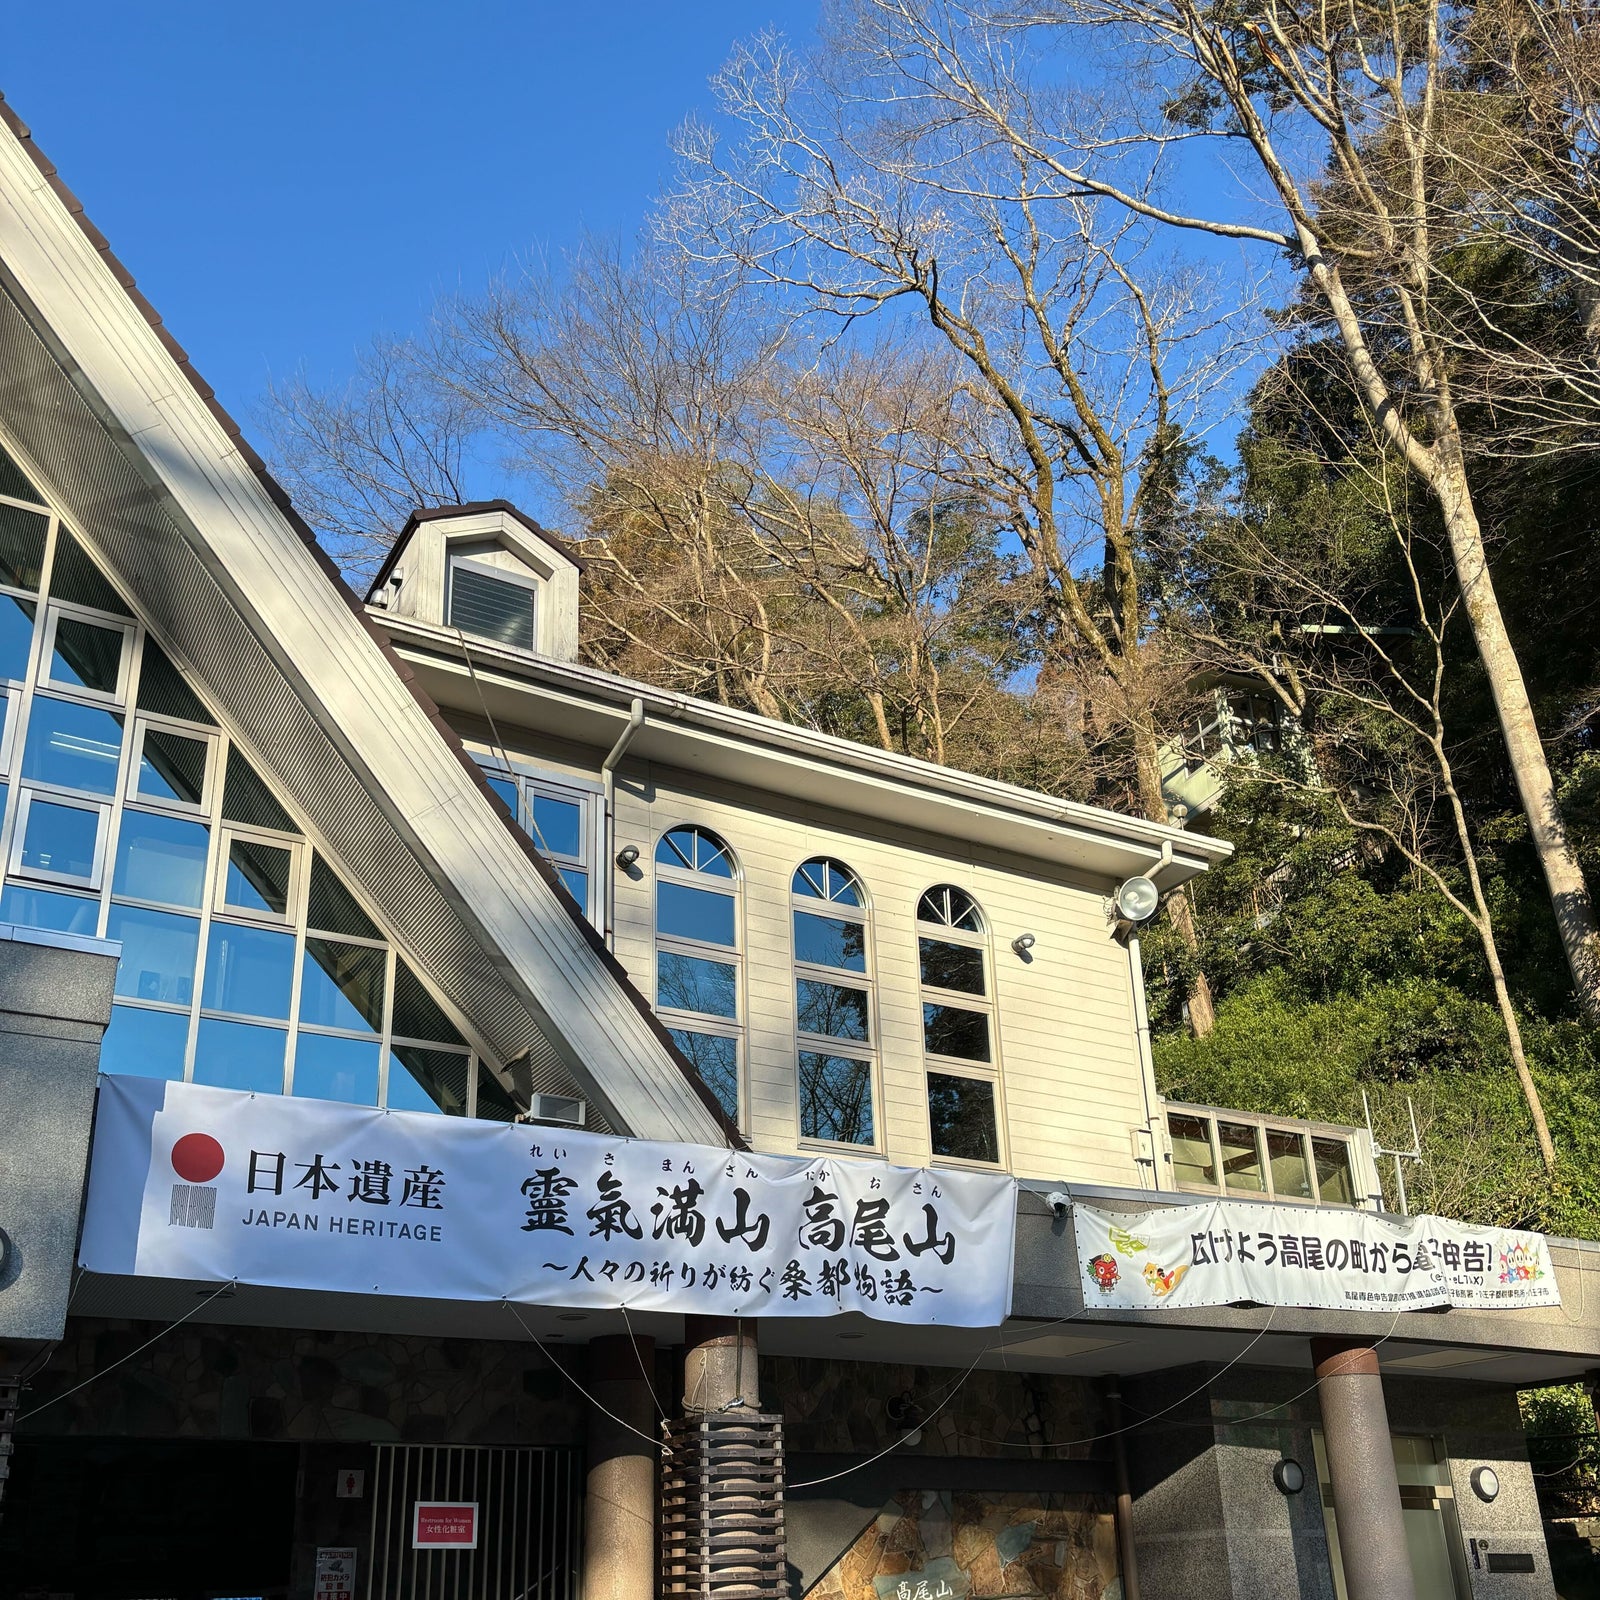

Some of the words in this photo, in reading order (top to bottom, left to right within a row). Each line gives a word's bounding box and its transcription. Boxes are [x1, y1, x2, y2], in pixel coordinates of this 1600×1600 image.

[247, 1149, 447, 1210] 日本遺産
[530, 1144, 567, 1159] れい
[604, 1152, 614, 1166] き
[662, 1158, 695, 1174] まん
[725, 1164, 759, 1179] さん
[912, 1182, 942, 1199] さん
[242, 1208, 319, 1232] JAPAN
[329, 1216, 442, 1242] HERITAGE
[798, 1185, 956, 1265] 高尾山
[426, 1525, 466, 1534] 女性化粧室
